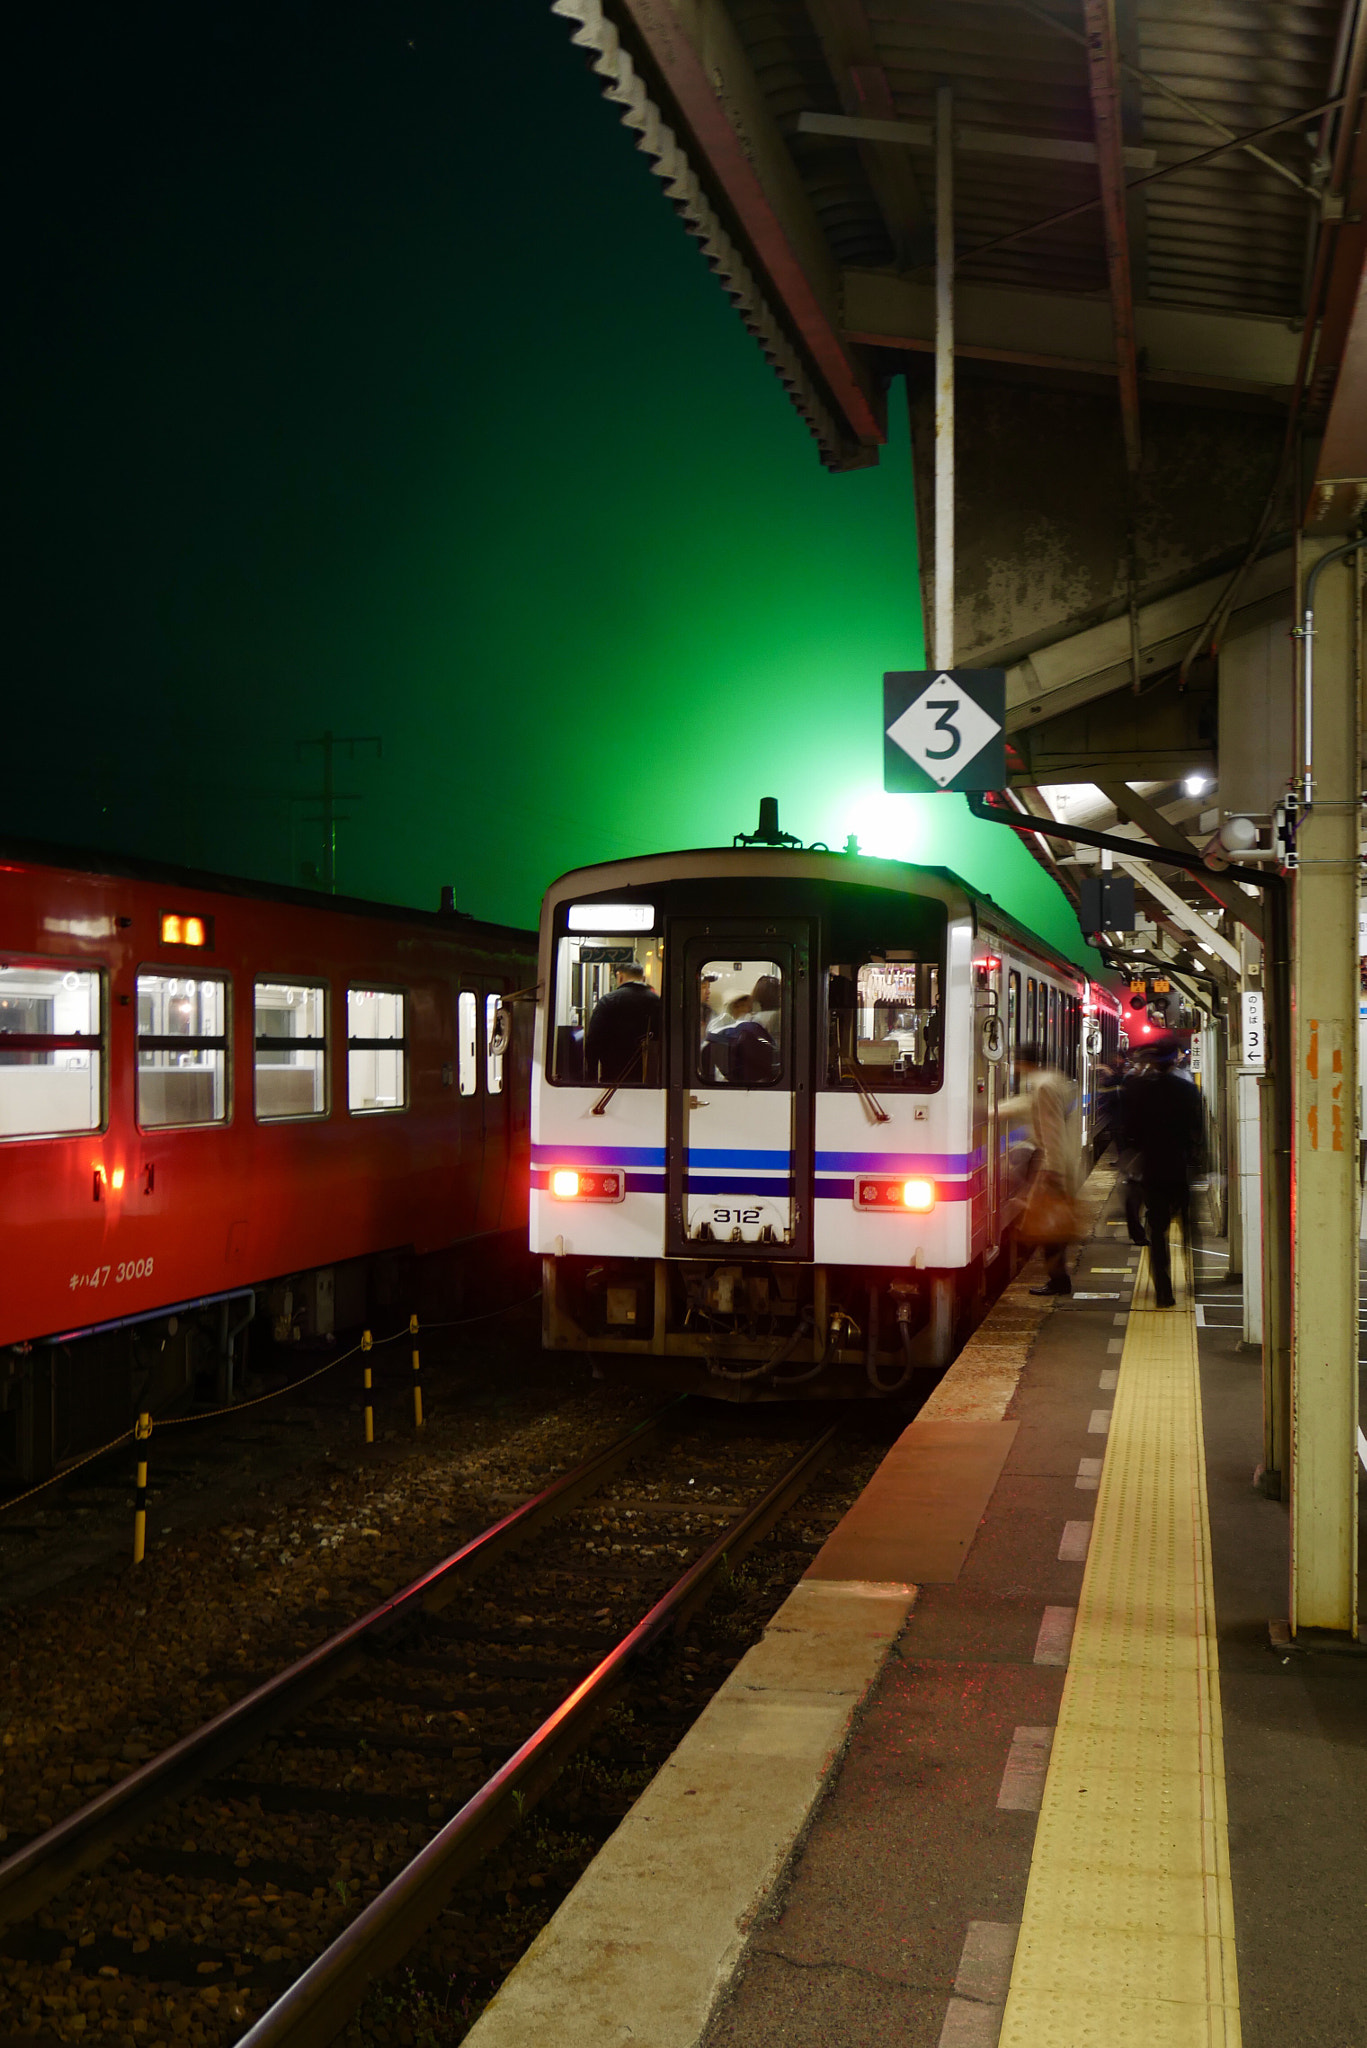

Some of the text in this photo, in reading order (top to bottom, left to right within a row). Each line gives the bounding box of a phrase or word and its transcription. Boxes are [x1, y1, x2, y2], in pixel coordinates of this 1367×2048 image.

[925, 700, 961, 760] 3
[581, 948, 632, 961] ワンマン
[1248, 995, 1259, 1046] のりば 3
[713, 1209, 760, 1224] 312
[115, 1256, 154, 1283] 3008
